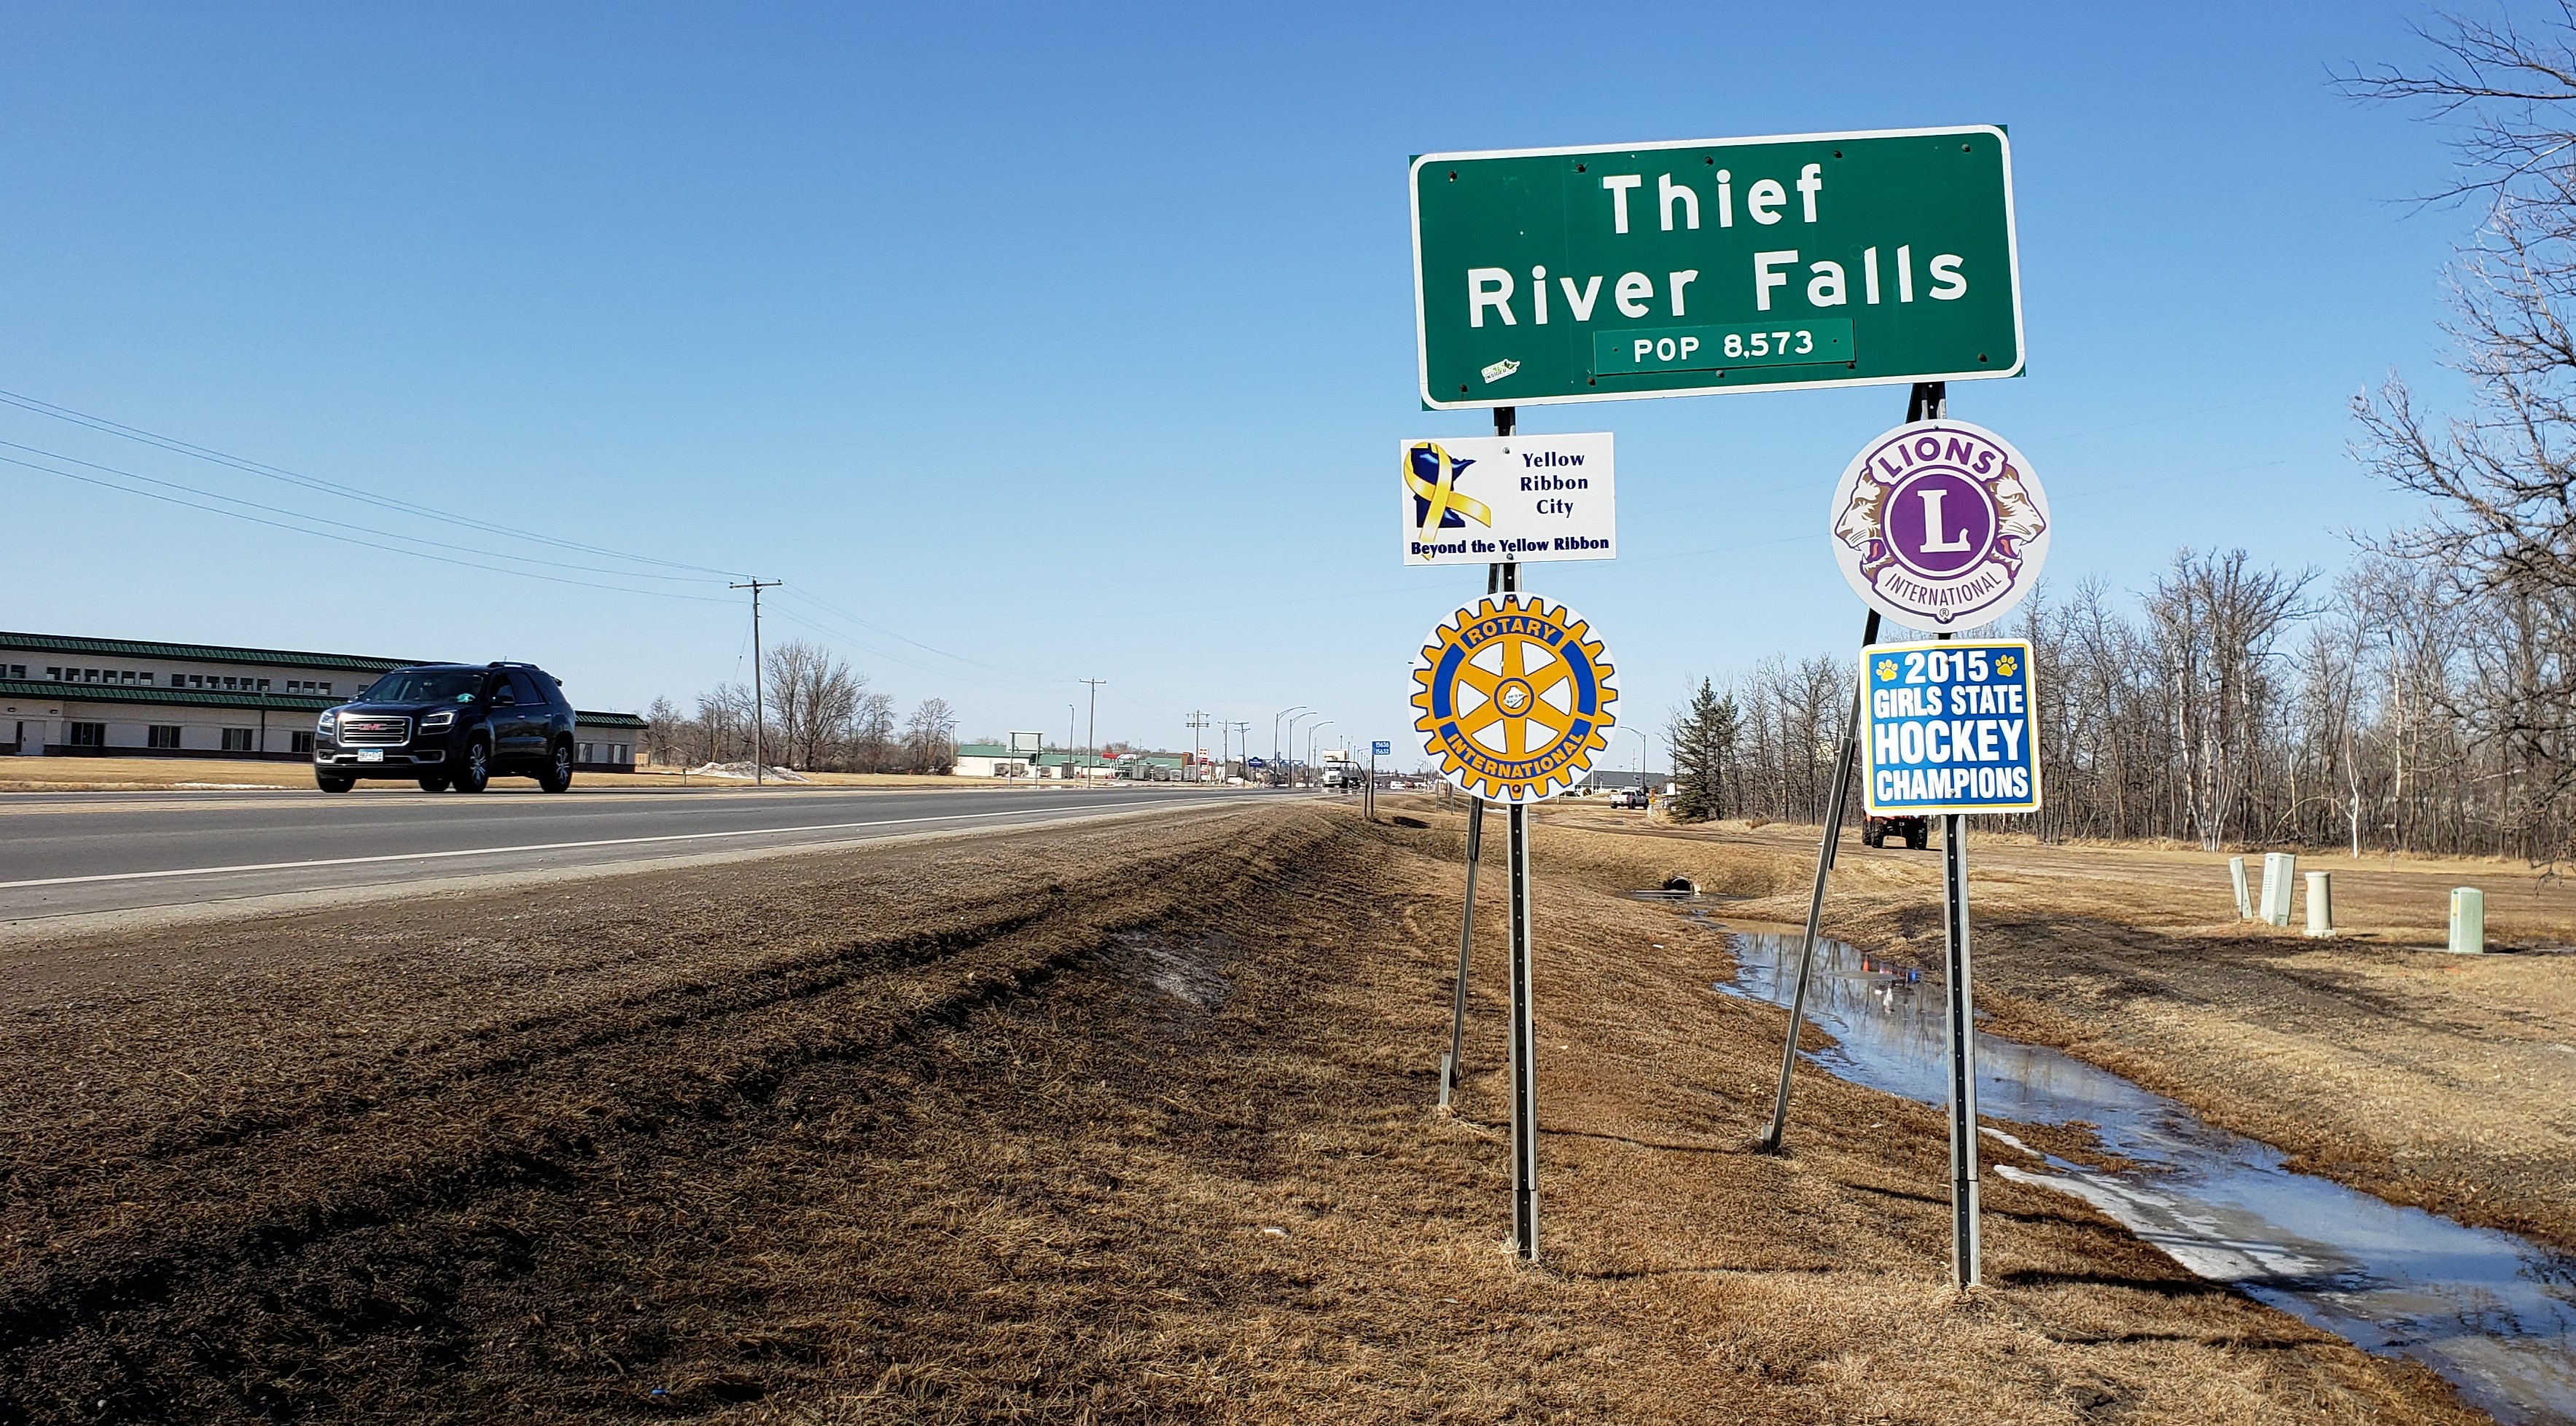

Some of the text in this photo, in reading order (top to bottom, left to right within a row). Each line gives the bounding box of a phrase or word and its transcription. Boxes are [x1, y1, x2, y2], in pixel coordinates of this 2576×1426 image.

[1602, 163, 1822, 234] Thief
[1467, 244, 1968, 328] River Falls
[1634, 330, 1814, 363] POP 8,573
[1522, 452, 1585, 468] Yellow
[1878, 437, 1997, 478] LIONS
[1521, 474, 1588, 492] Ribbon
[1536, 498, 1574, 518] City
[1917, 489, 1971, 553] L
[1411, 536, 1609, 558] Beyond the Yellow Ribbon
[1884, 571, 2002, 606] INTERNATIONAL
[1467, 618, 1558, 645] ROTARY
[1904, 650, 1989, 684] 2015
[1873, 684, 2024, 718] GIRLS STATE
[1447, 733, 1585, 777] INTERNATIONAL
[1874, 719, 2024, 765] HOCKEY
[1876, 767, 2029, 802] CHAMPIONS
